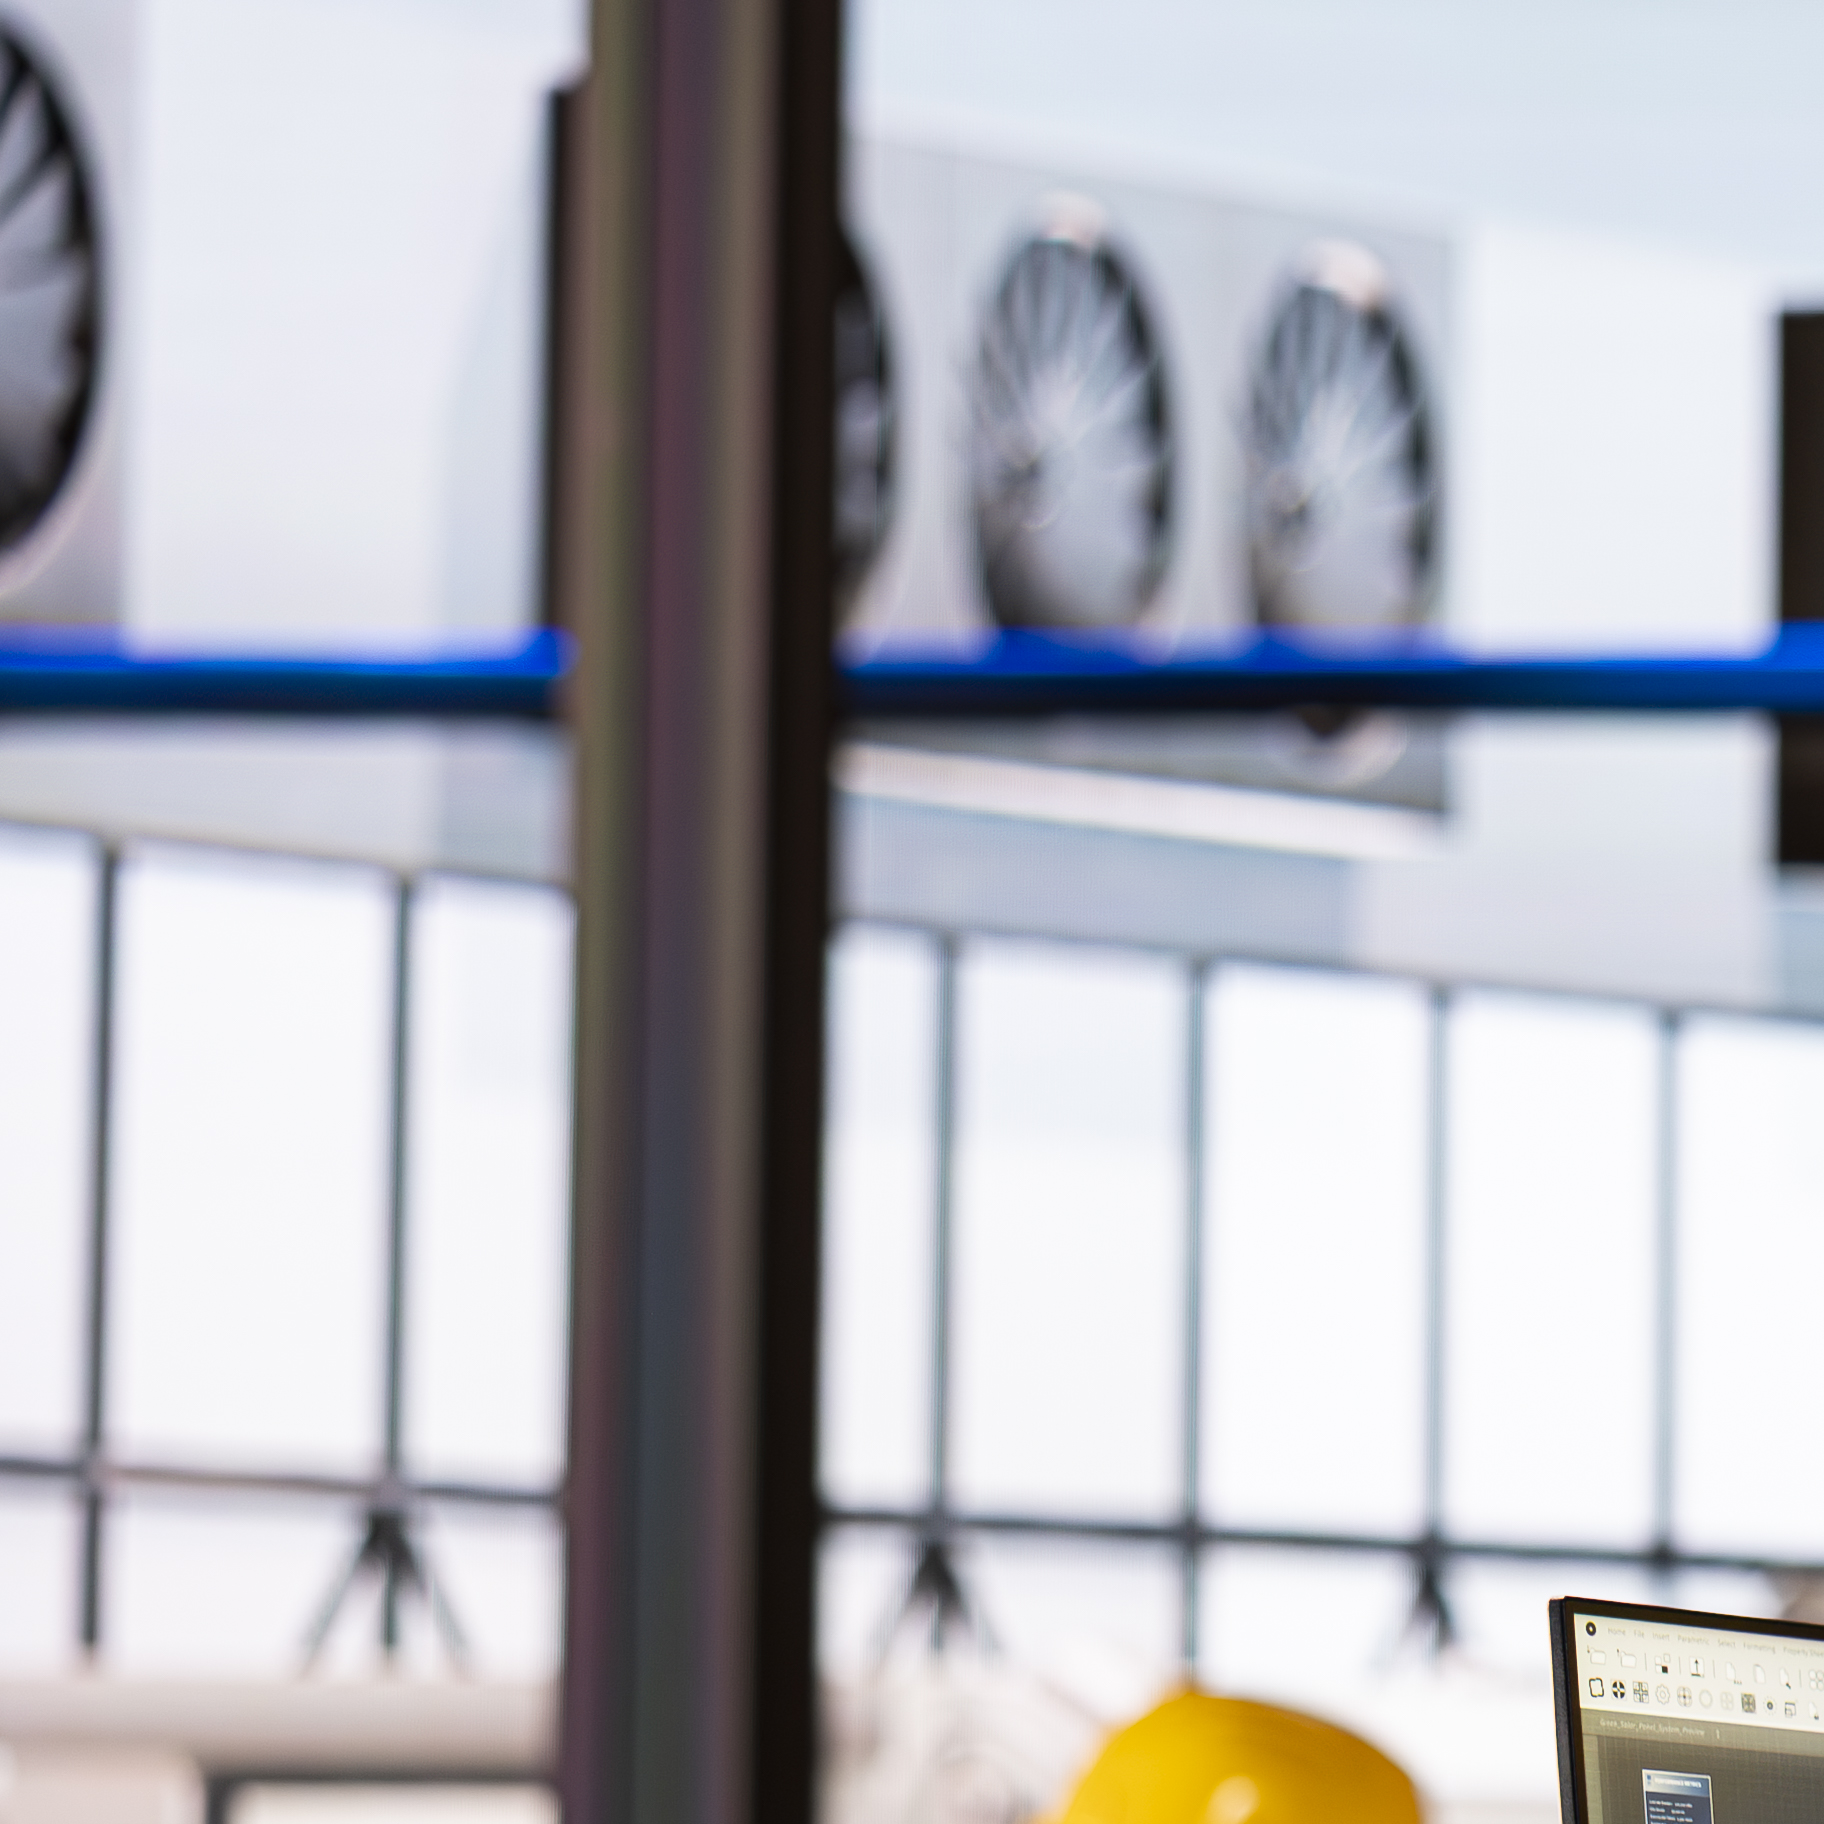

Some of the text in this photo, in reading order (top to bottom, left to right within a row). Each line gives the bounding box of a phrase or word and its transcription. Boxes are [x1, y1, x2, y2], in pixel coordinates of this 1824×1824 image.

[1608, 1627, 1626, 1636] Home
[1634, 1629, 1645, 1638] File
[1653, 1631, 1670, 1641] Insert
